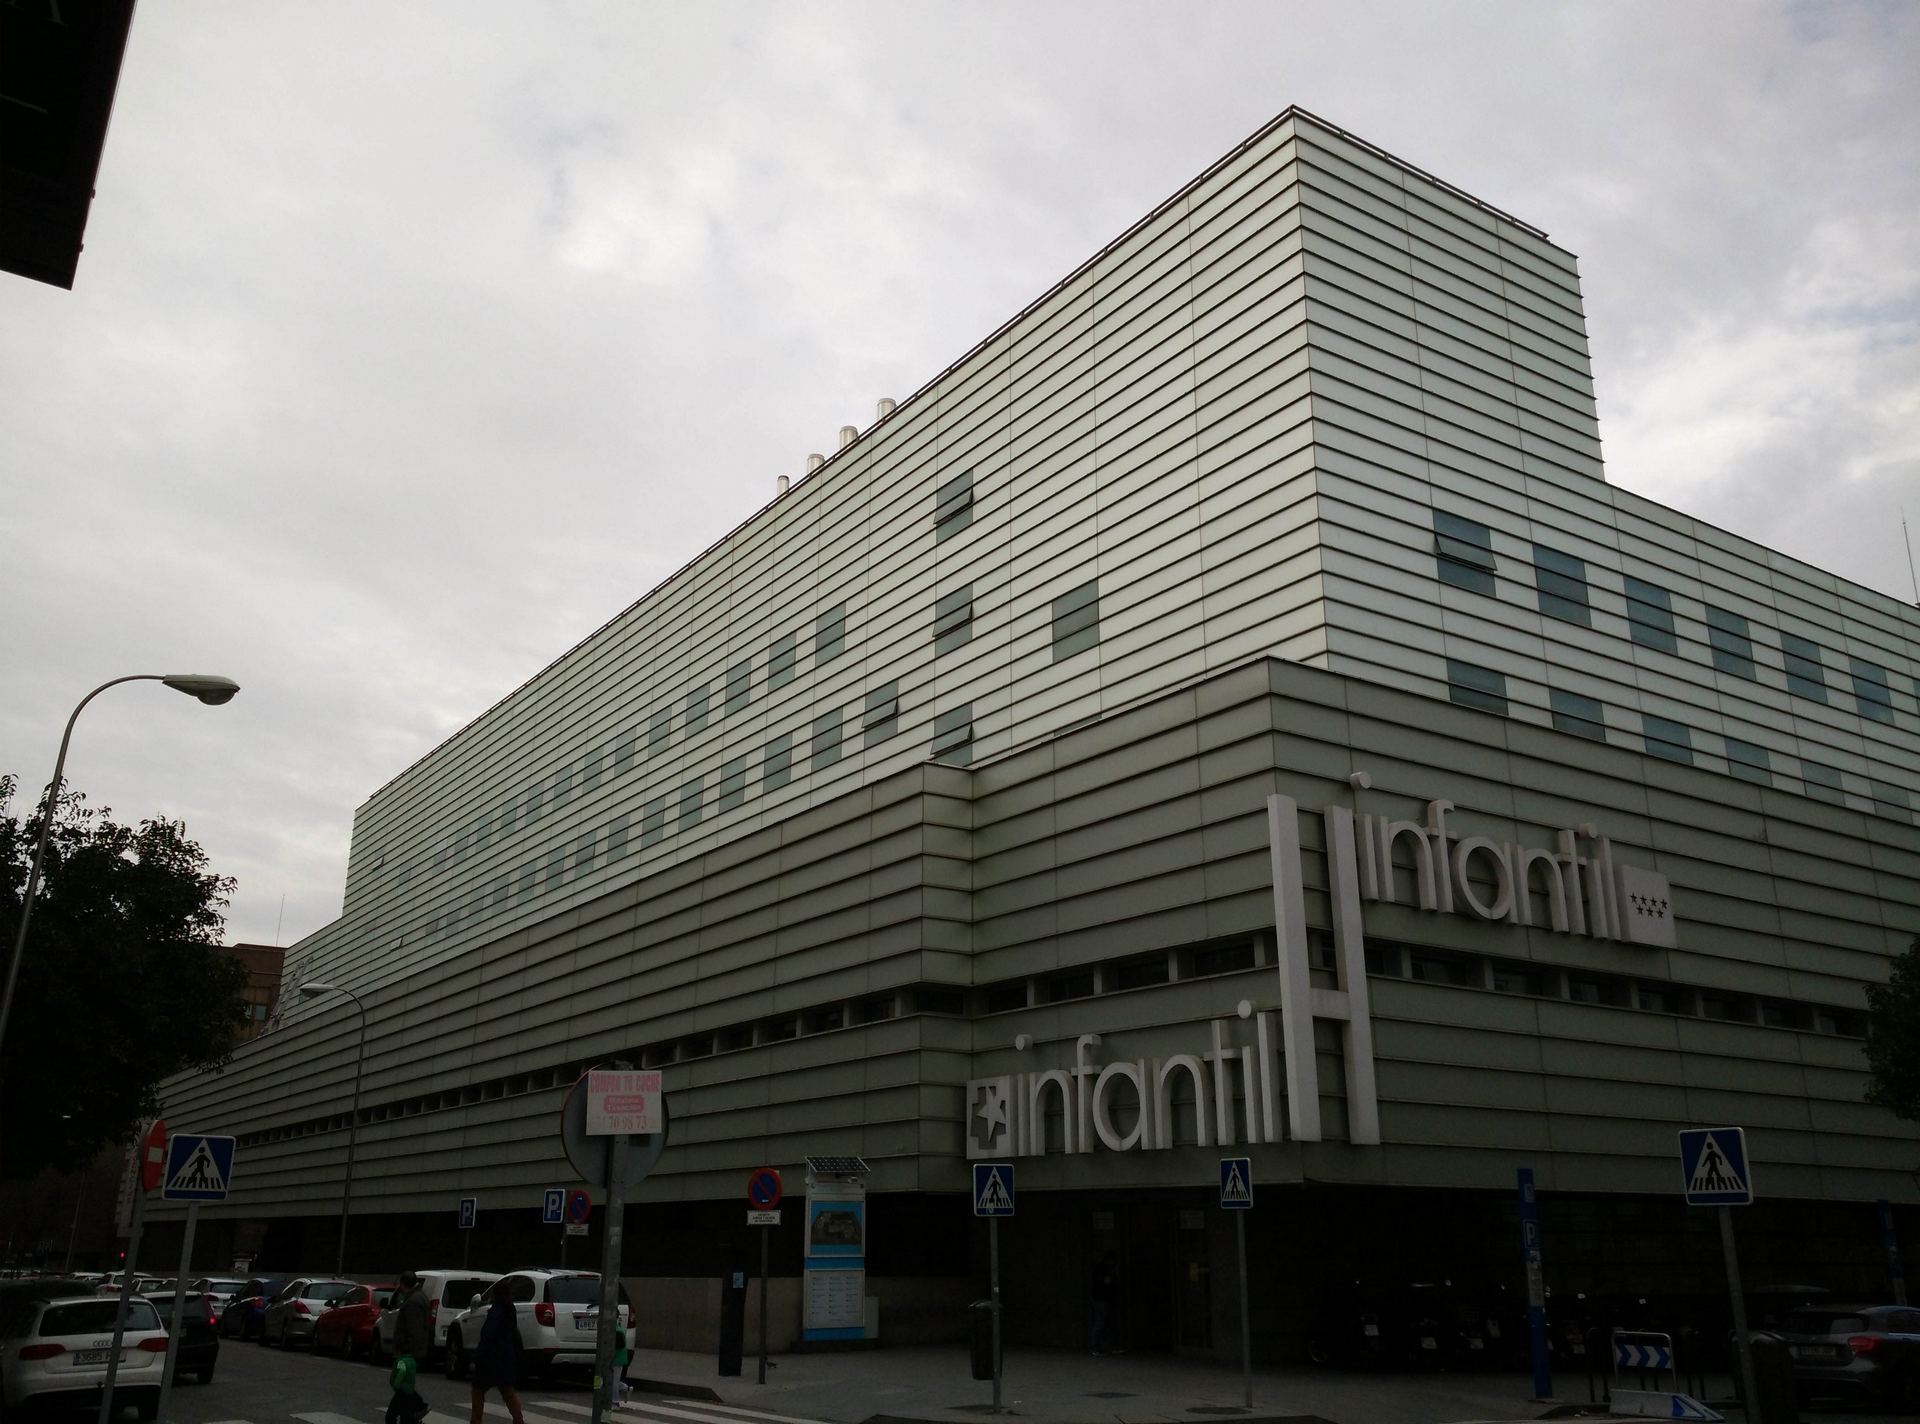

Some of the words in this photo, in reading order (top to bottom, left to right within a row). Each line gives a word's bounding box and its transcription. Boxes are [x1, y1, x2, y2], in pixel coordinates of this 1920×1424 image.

[1349, 771, 1622, 941] infantil
[1015, 999, 1283, 1157] infantil
[462, 1201, 472, 1225] P
[547, 1193, 560, 1219] P
